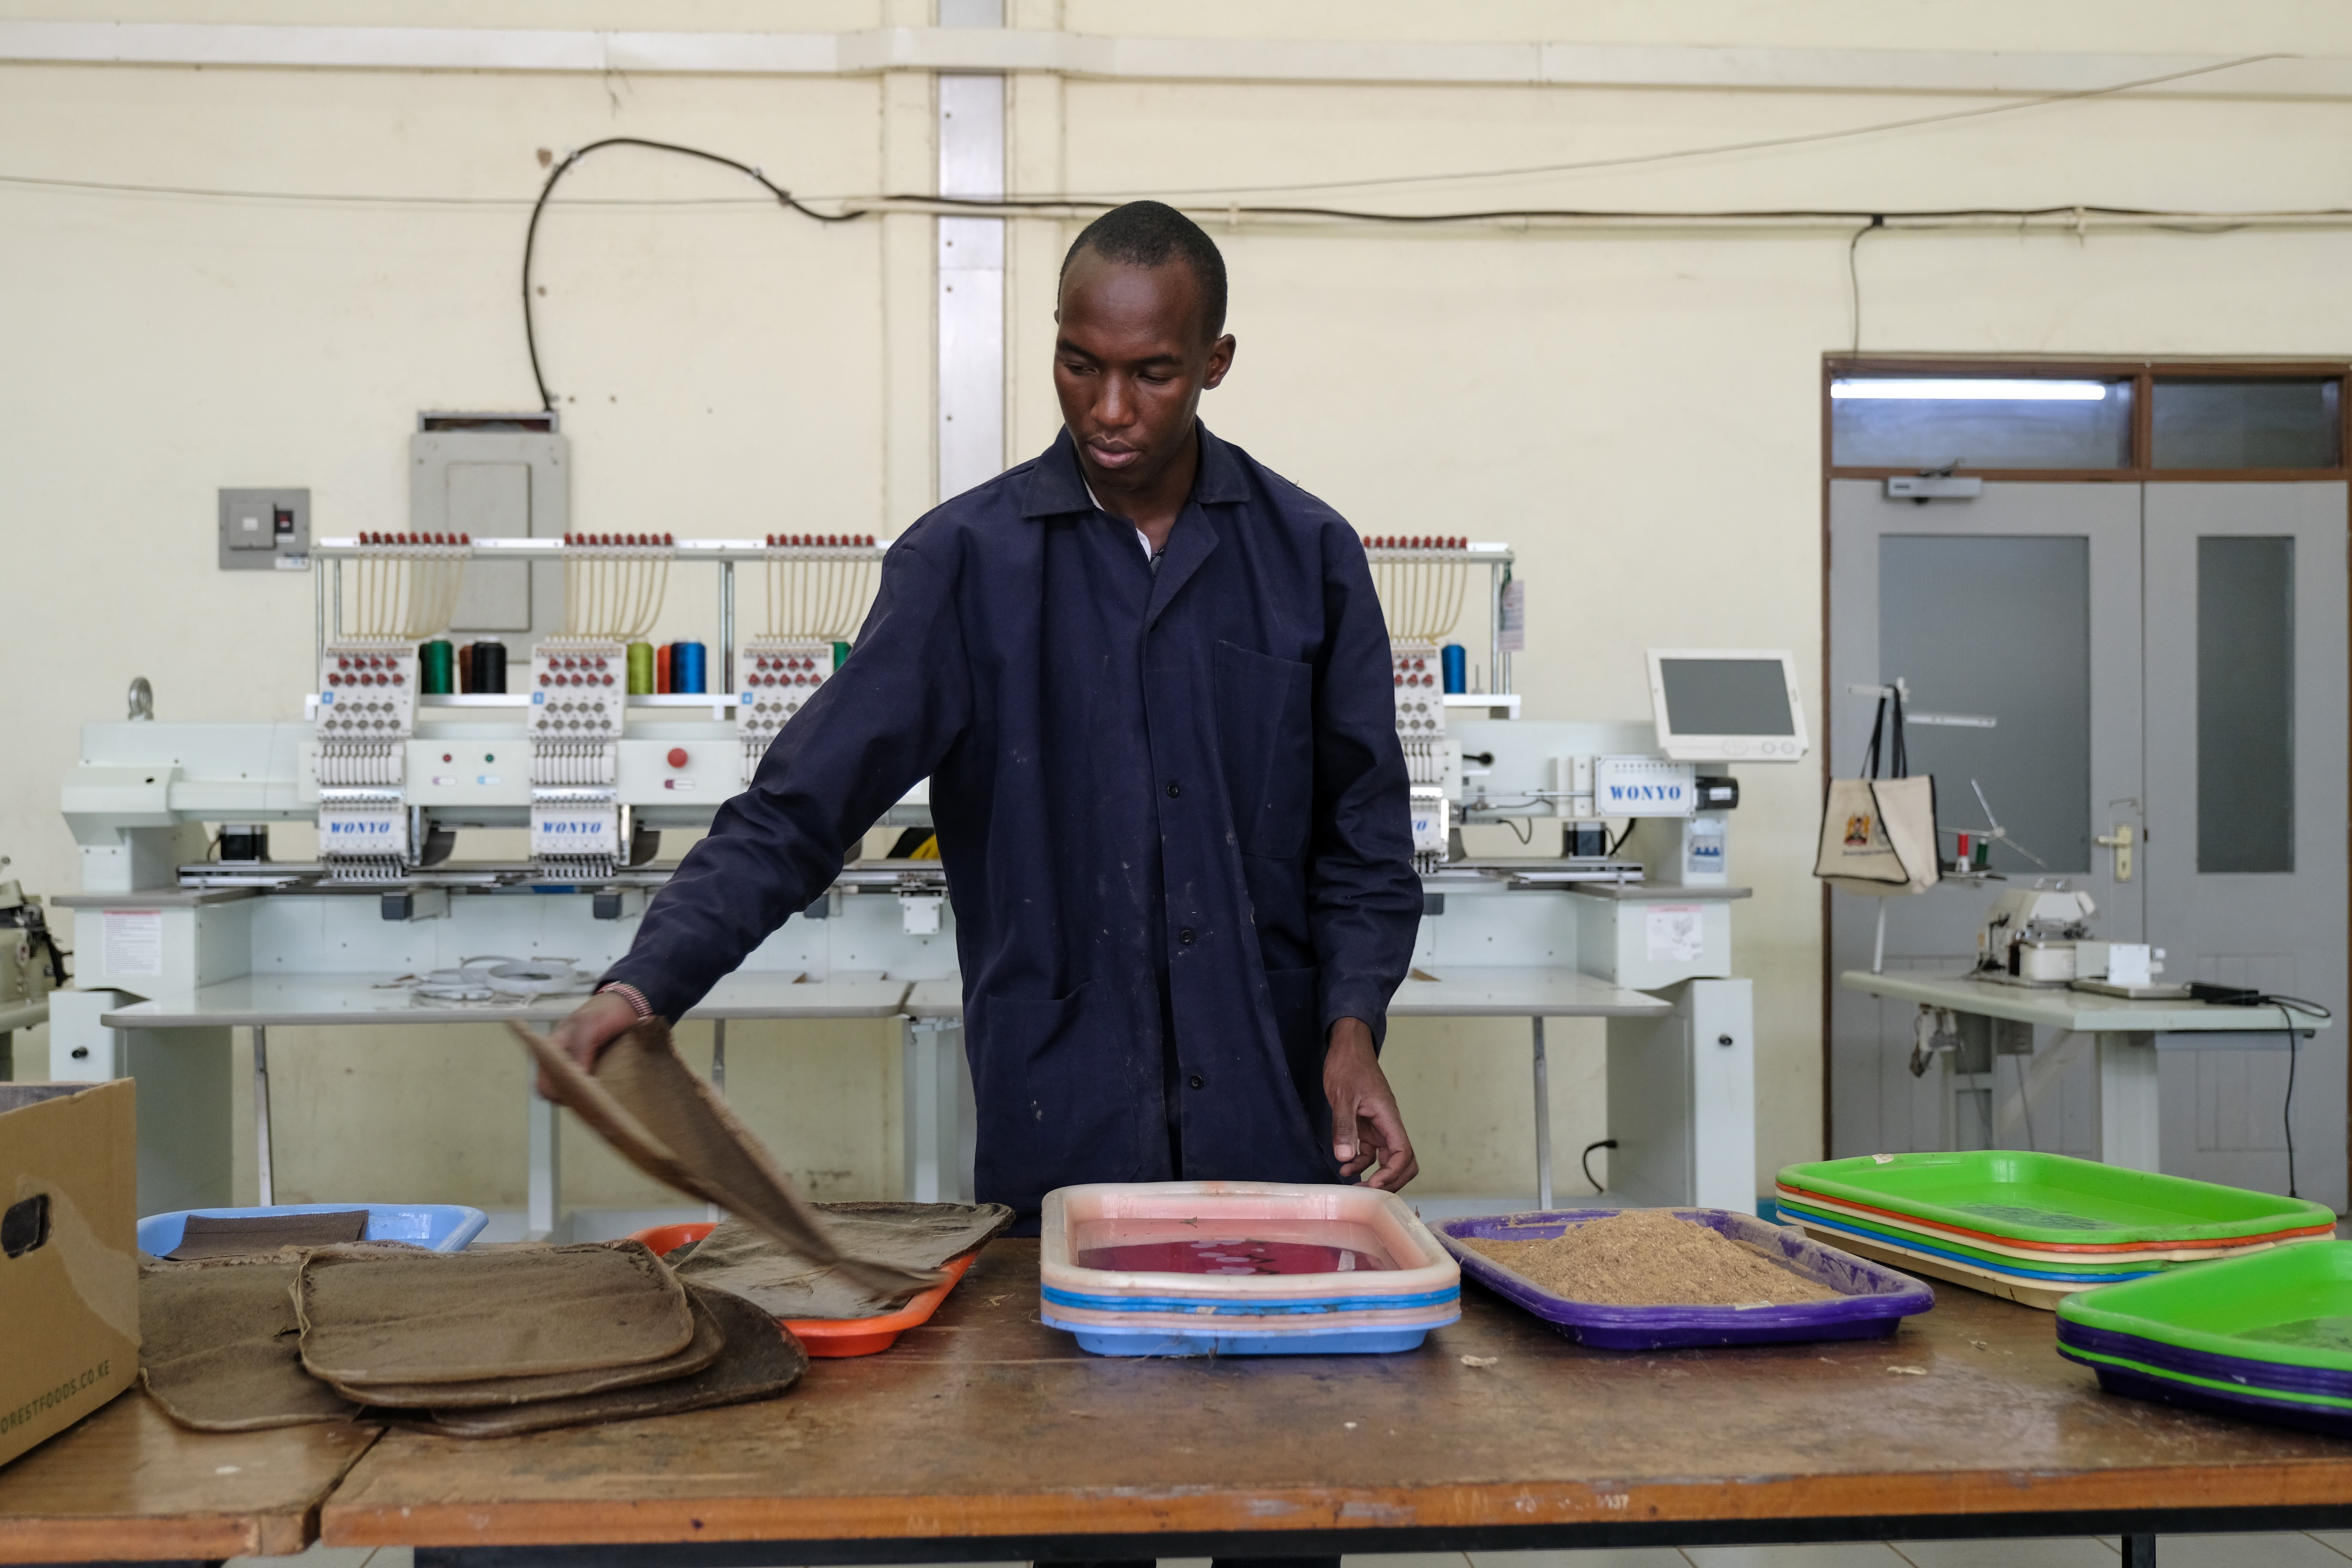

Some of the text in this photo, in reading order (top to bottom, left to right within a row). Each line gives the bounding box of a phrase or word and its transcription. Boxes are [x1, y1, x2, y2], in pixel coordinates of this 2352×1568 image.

[1610, 785, 1682, 801] WONYO
[331, 822, 390, 833] WONYO
[543, 822, 602, 833] WONYO
